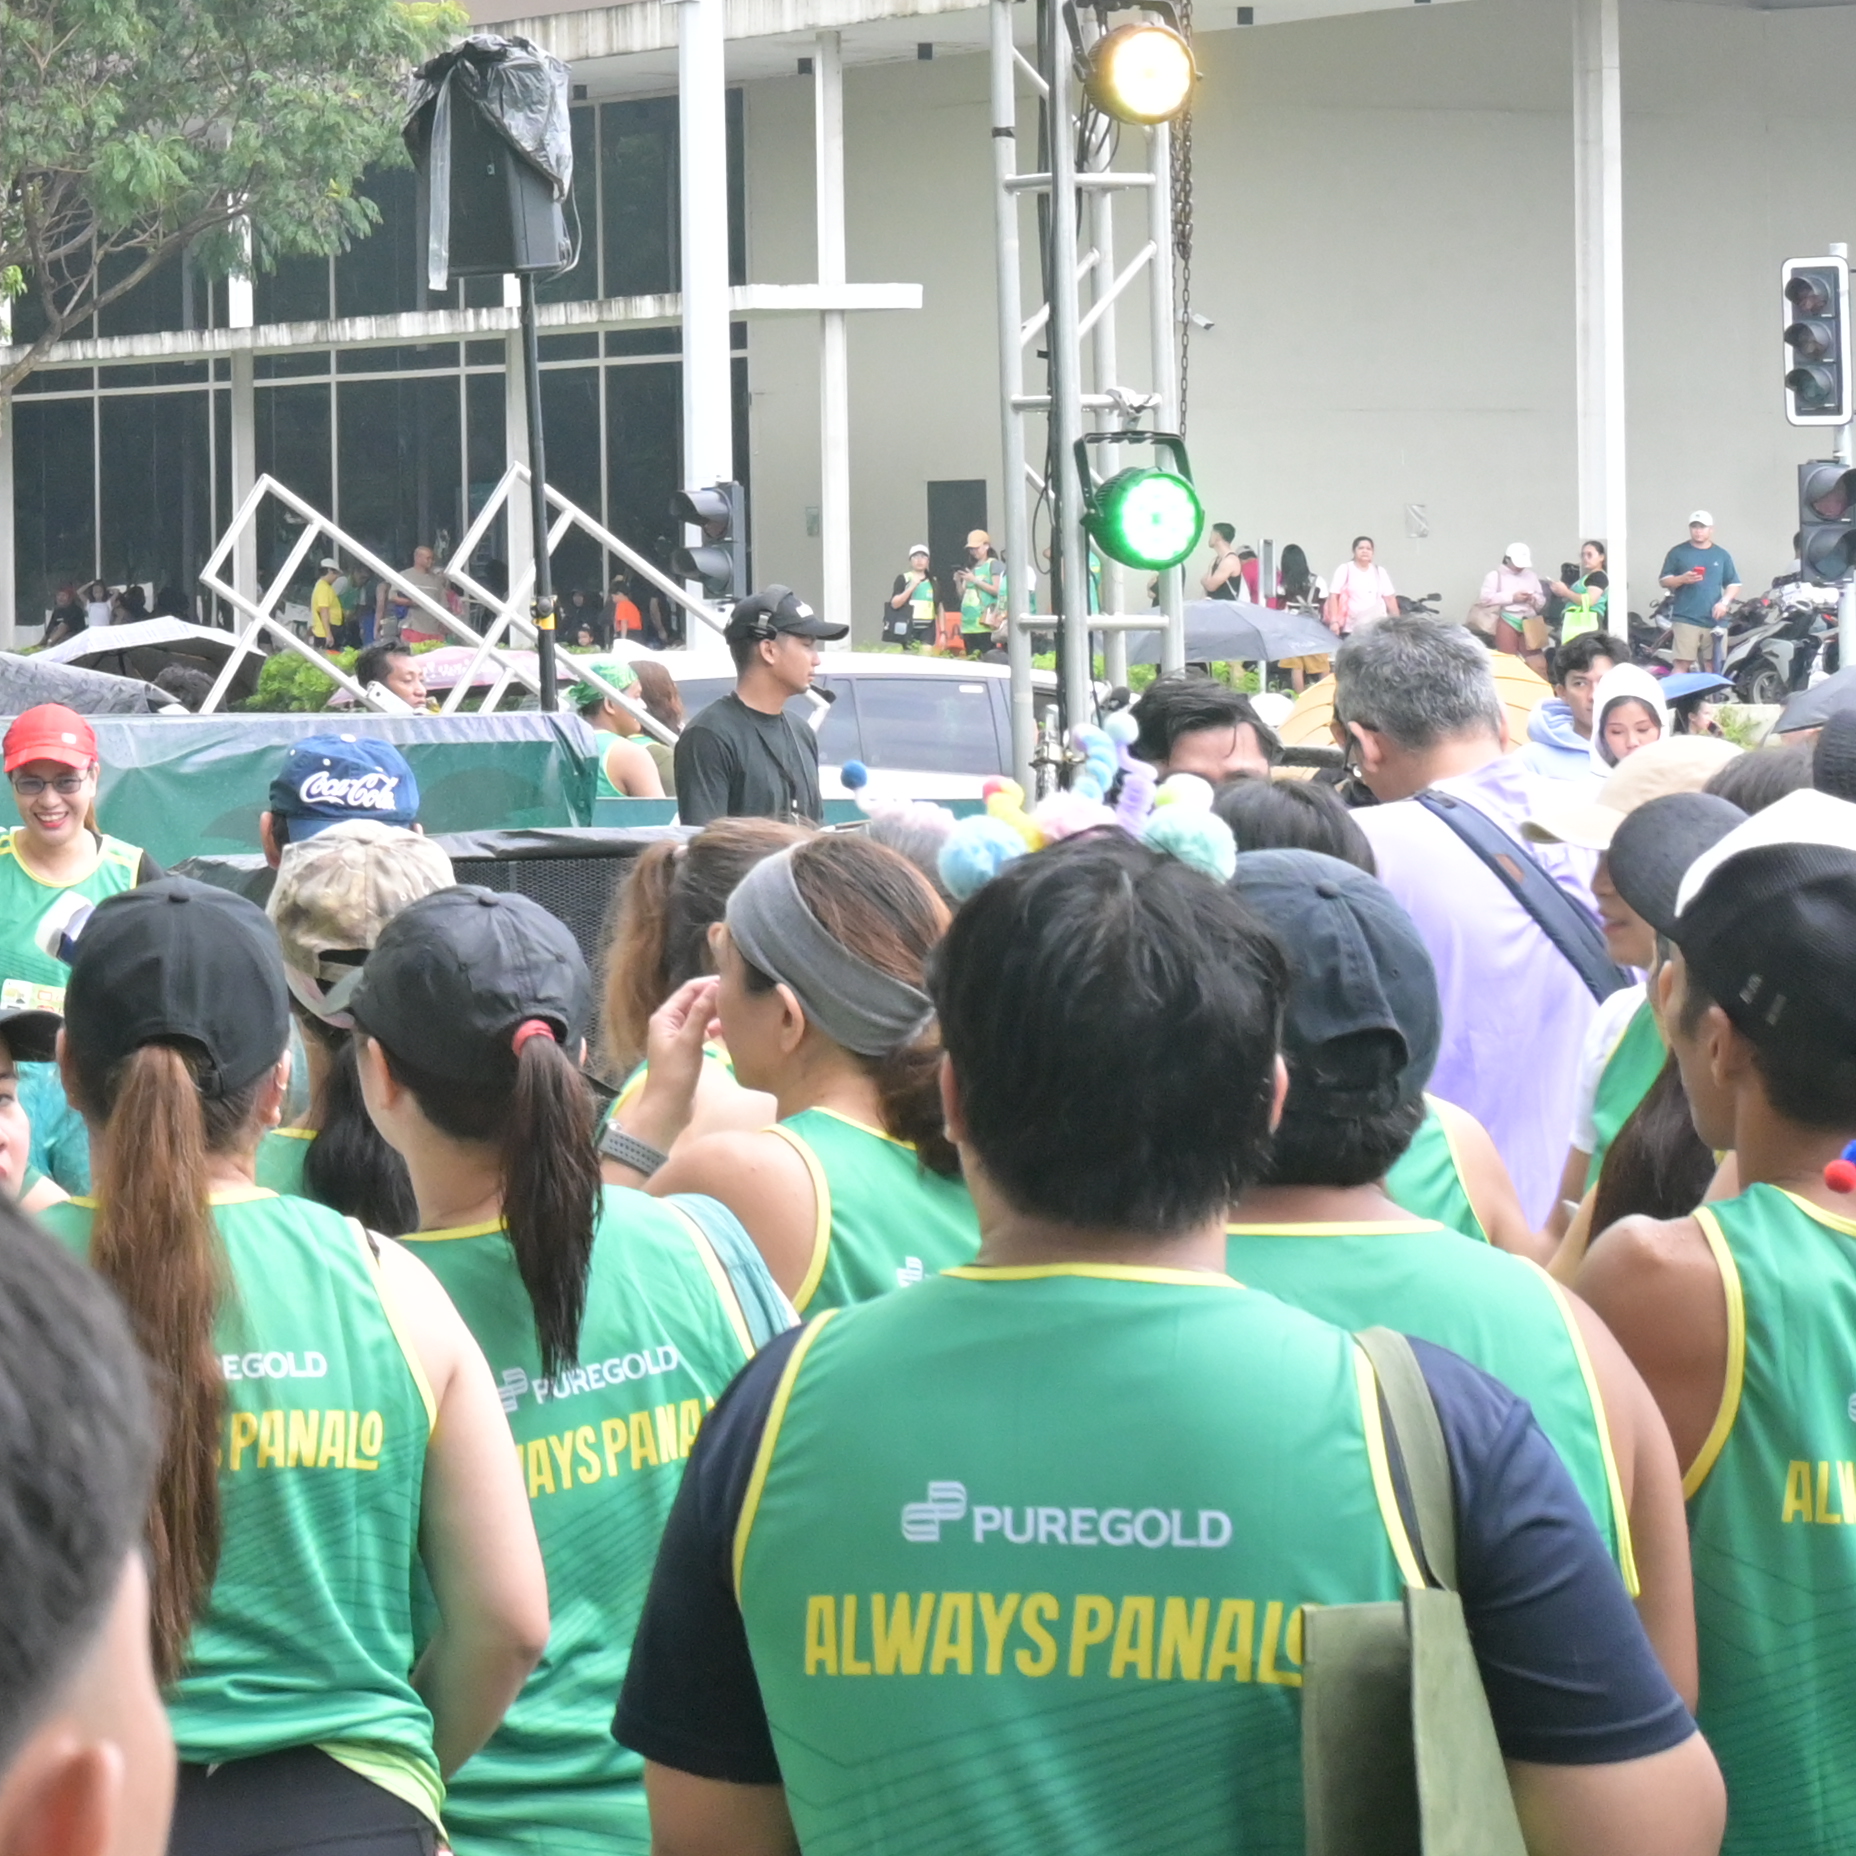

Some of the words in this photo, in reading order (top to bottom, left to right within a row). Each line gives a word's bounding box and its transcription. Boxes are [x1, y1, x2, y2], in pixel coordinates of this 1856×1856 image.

[217, 1350, 328, 1381] EGOLD
[532, 1344, 679, 1405] PUREGOLD
[230, 1409, 384, 1472] PANALO
[600, 1396, 715, 1478] PANA
[972, 1505, 1233, 1549] PUREGOLD
[804, 1591, 1059, 1678] ALWAYS
